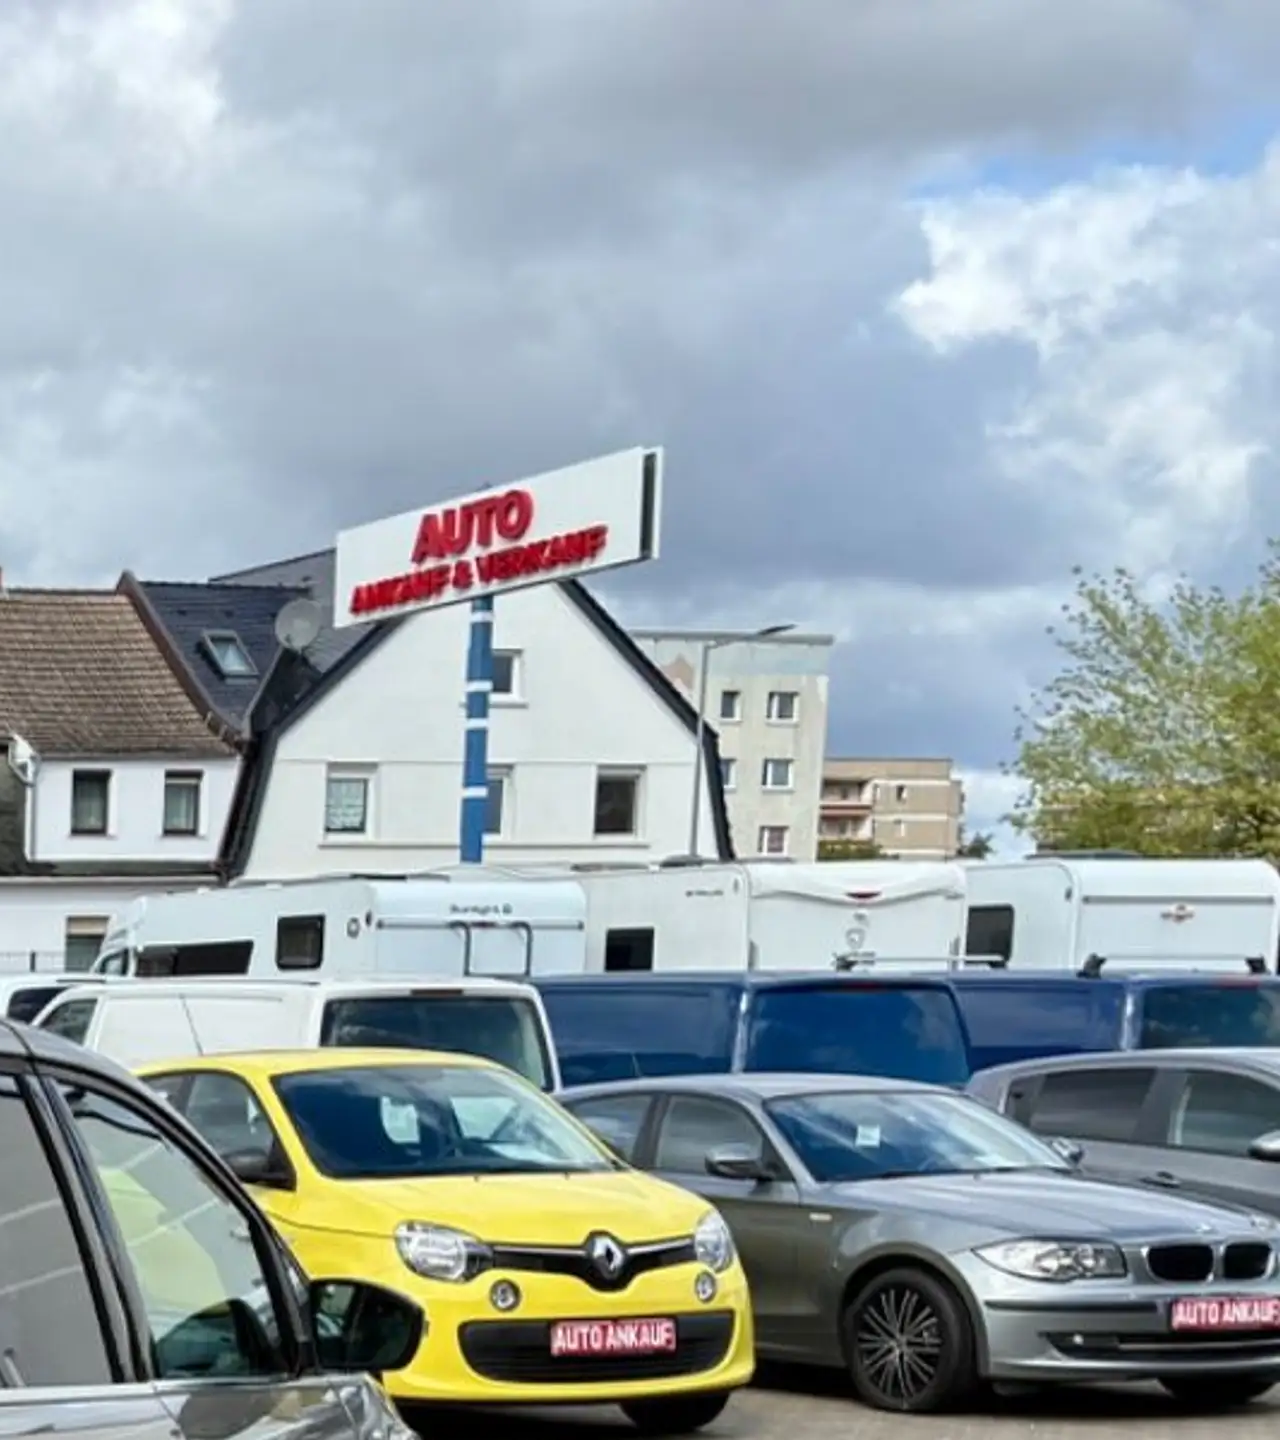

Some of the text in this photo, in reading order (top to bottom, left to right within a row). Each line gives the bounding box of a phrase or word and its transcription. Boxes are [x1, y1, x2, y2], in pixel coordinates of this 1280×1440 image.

[411, 488, 535, 564] AUTO
[349, 524, 609, 615] ANKAUF & VERKAUF
[554, 1321, 674, 1352] AUTO ANKAUF
[1174, 1301, 1219, 1325] AUTO
